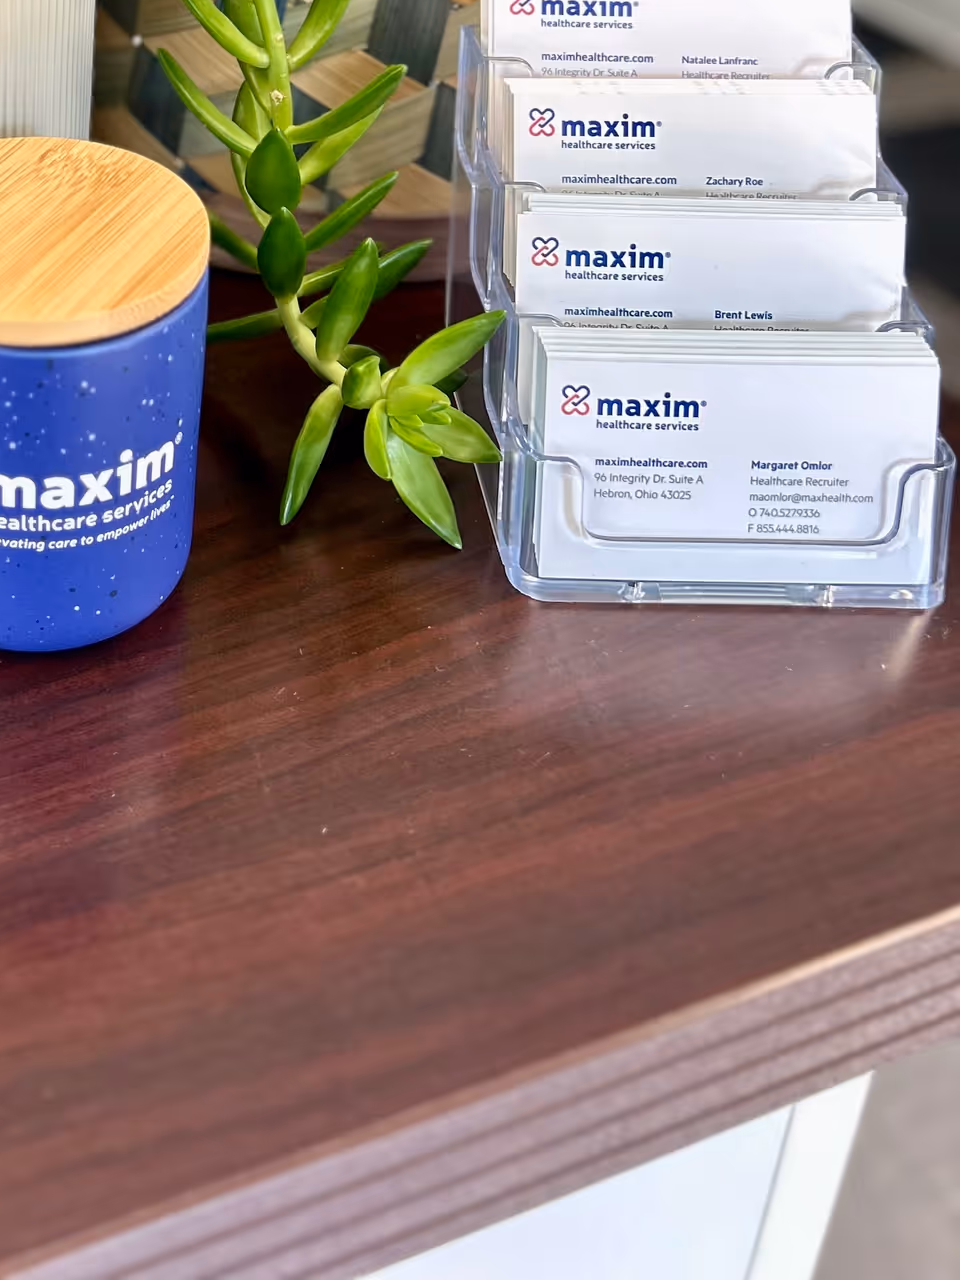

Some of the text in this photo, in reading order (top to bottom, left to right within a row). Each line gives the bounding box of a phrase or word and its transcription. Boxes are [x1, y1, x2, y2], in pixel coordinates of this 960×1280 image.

[541, 19, 633, 29] healthcare services
[541, 52, 654, 63] maximhealthcare.com
[682, 56, 717, 65] Natalee
[561, 140, 656, 150] healthcare services
[562, 174, 677, 185] maximhealthcare.com
[706, 176, 763, 187] Zachary Roe
[565, 270, 664, 282] healthcare services
[564, 307, 673, 318] maximhealthcare.com
[714, 310, 773, 320] Brent Lewis
[596, 419, 699, 431] healthcare services
[595, 457, 708, 468] maximhealthcare.com
[751, 460, 833, 472] Margaret Omlor
[594, 472, 607, 482] 96
[609, 473, 651, 485] Integrity
[668, 474, 694, 484] Suite
[696, 475, 704, 484] A
[750, 476, 849, 487] Healthcare Recruiter
[594, 489, 692, 500] Hebron, Ohio 43025
[102, 478, 173, 524] services
[48, 536, 77, 549] care
[80, 534, 94, 546] to
[96, 515, 149, 543] empower
[747, 523, 755, 533] F
